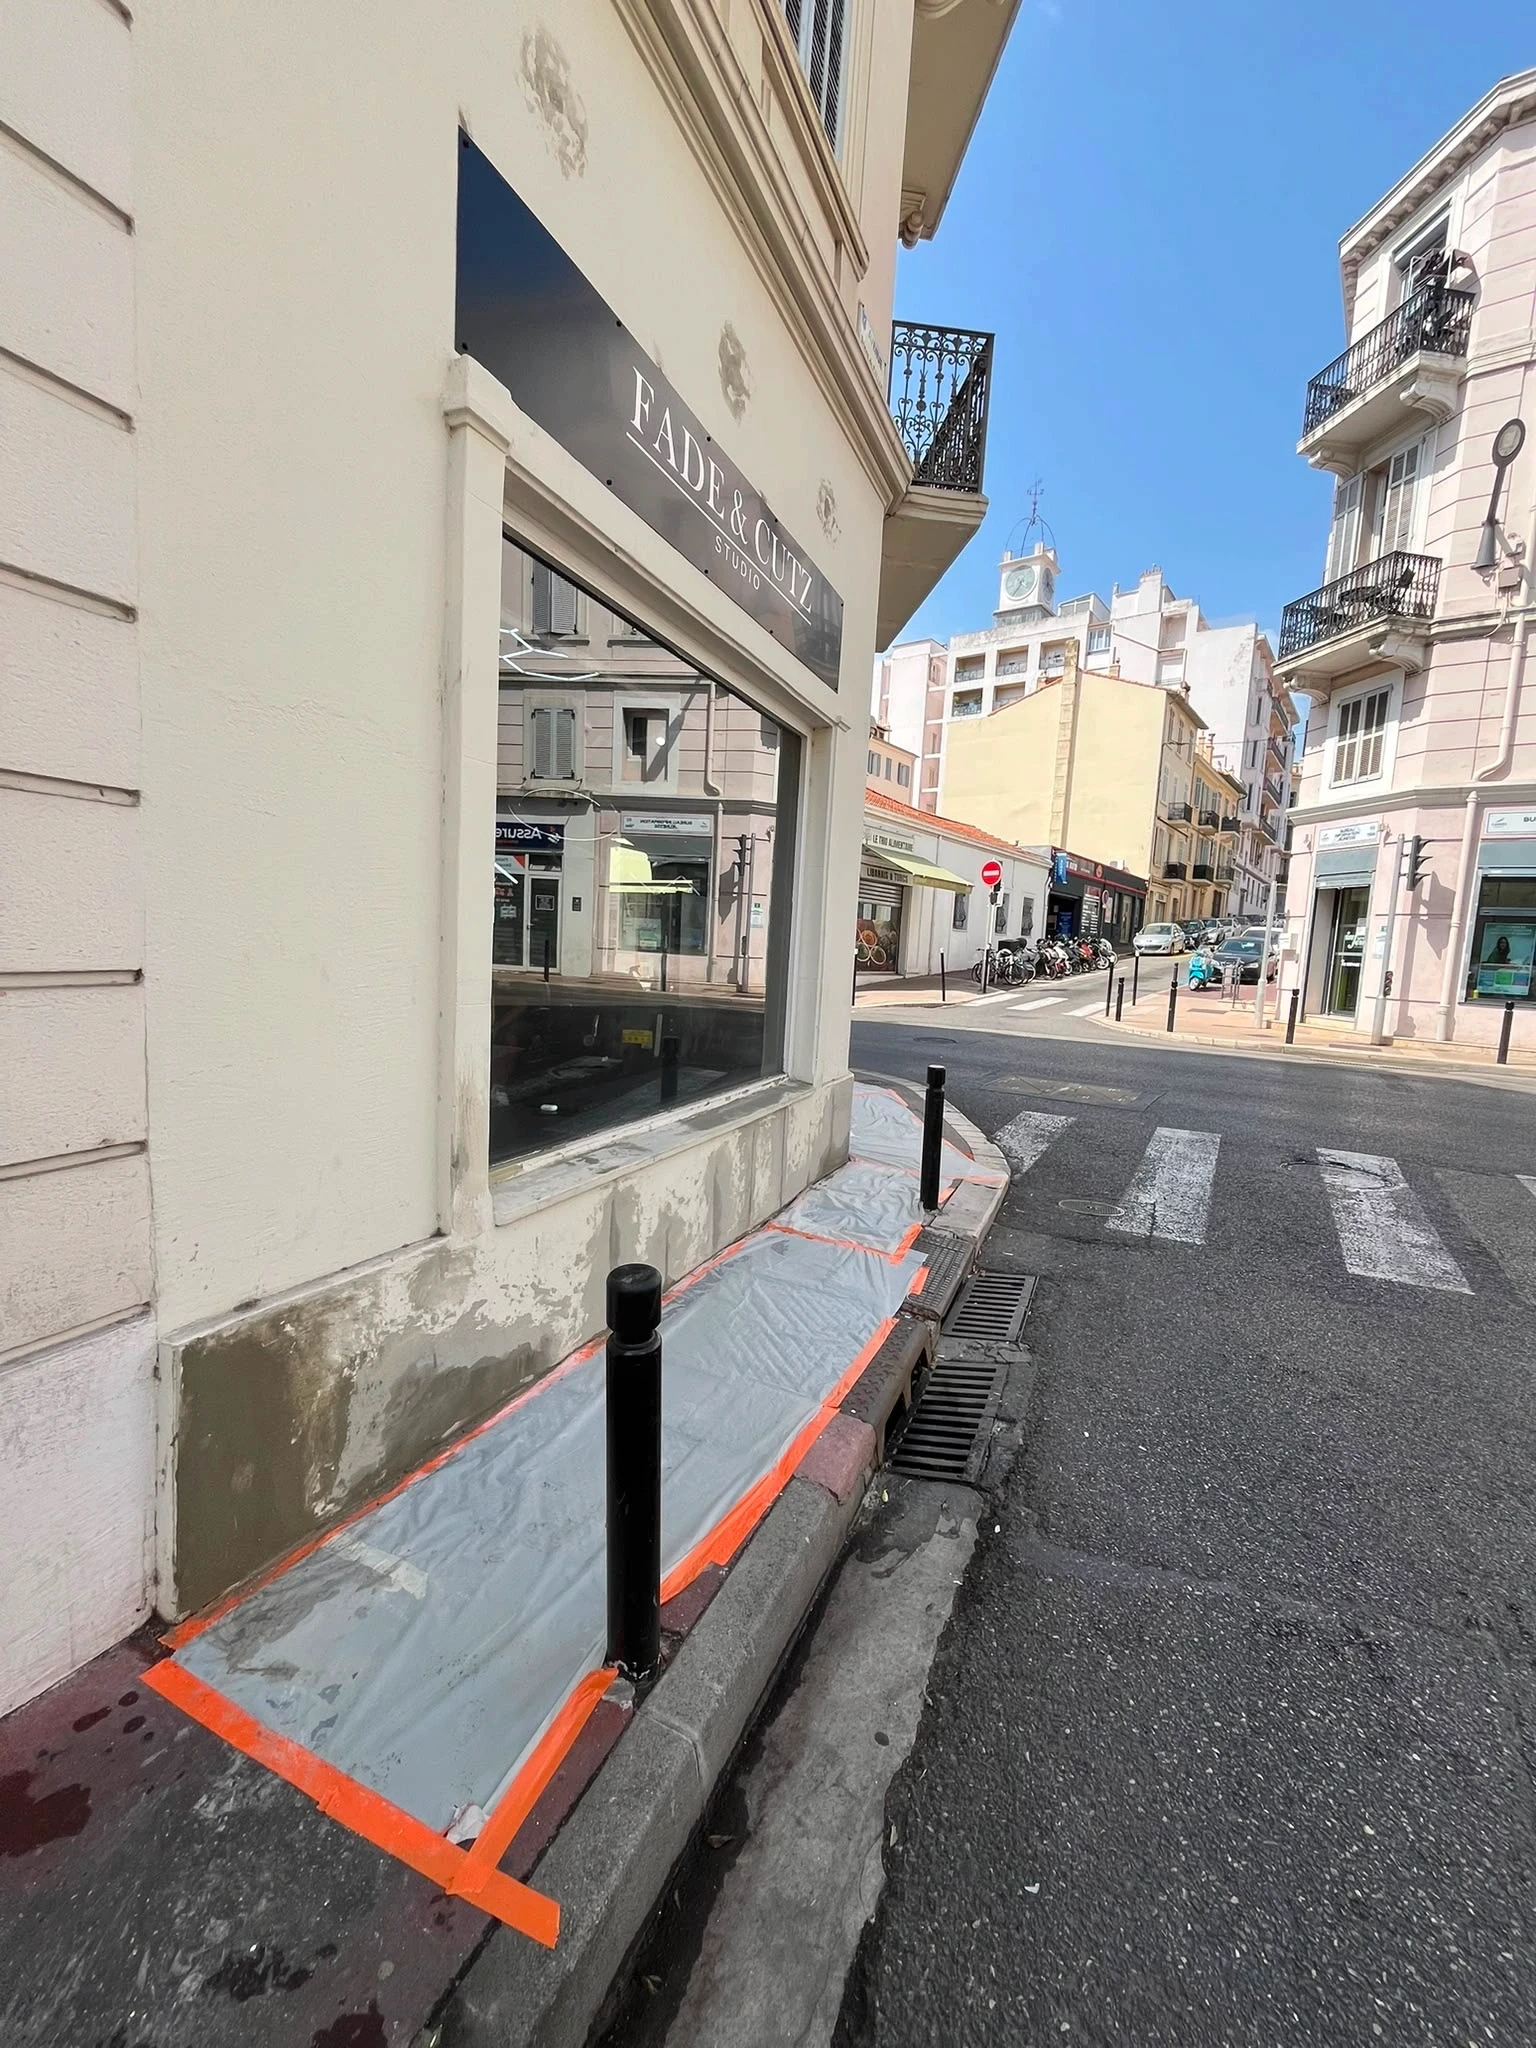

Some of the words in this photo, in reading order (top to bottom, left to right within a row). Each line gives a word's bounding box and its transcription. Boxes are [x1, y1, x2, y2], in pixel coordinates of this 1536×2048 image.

[630, 366, 725, 520] FADE
[730, 489, 748, 545] &
[755, 518, 813, 614] CUTZ
[714, 535, 761, 590] STUDIO
